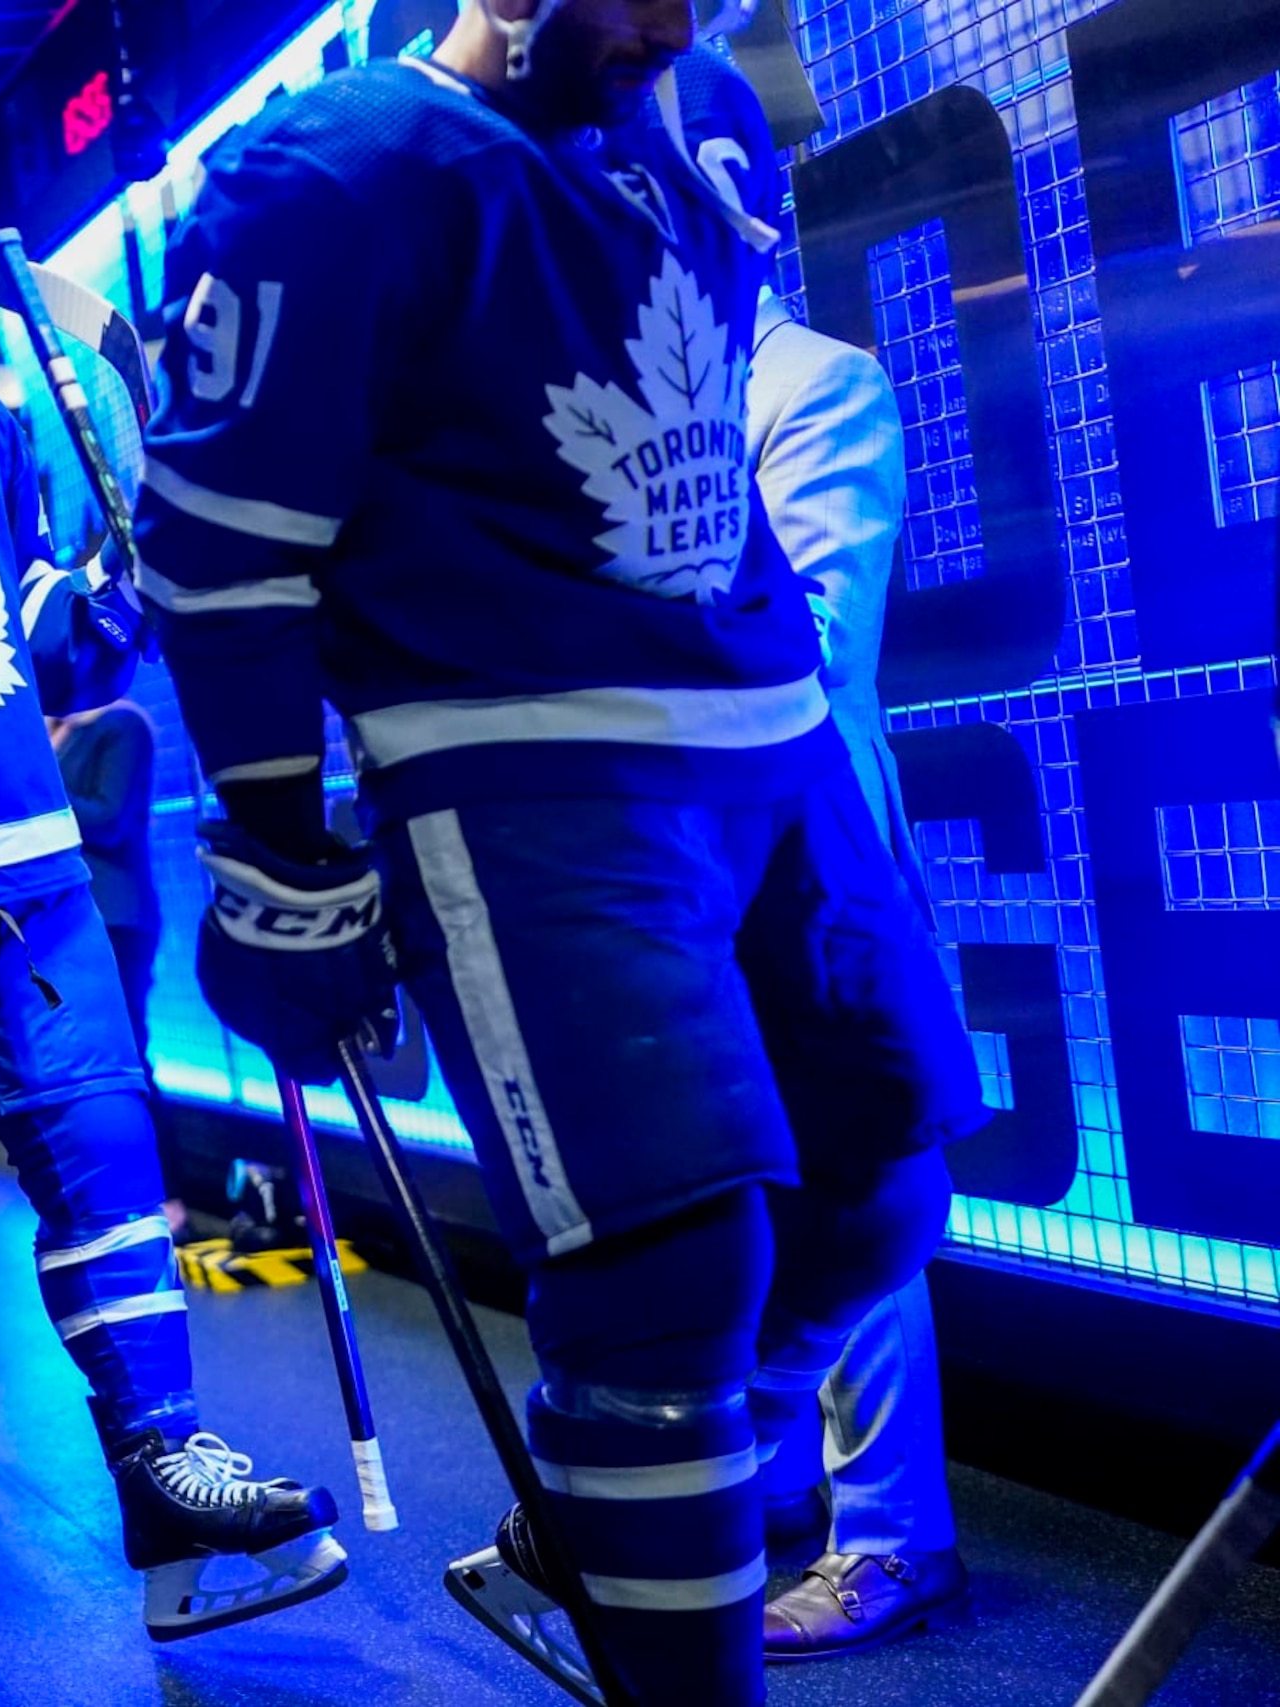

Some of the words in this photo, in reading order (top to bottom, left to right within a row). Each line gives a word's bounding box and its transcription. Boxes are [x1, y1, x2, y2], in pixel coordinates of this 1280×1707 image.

[183, 271, 284, 408] 91
[611, 418, 745, 490] TORONTO
[646, 466, 740, 518] MAPLE
[646, 505, 740, 558] LEAFS
[504, 1081, 551, 1189] CCM
